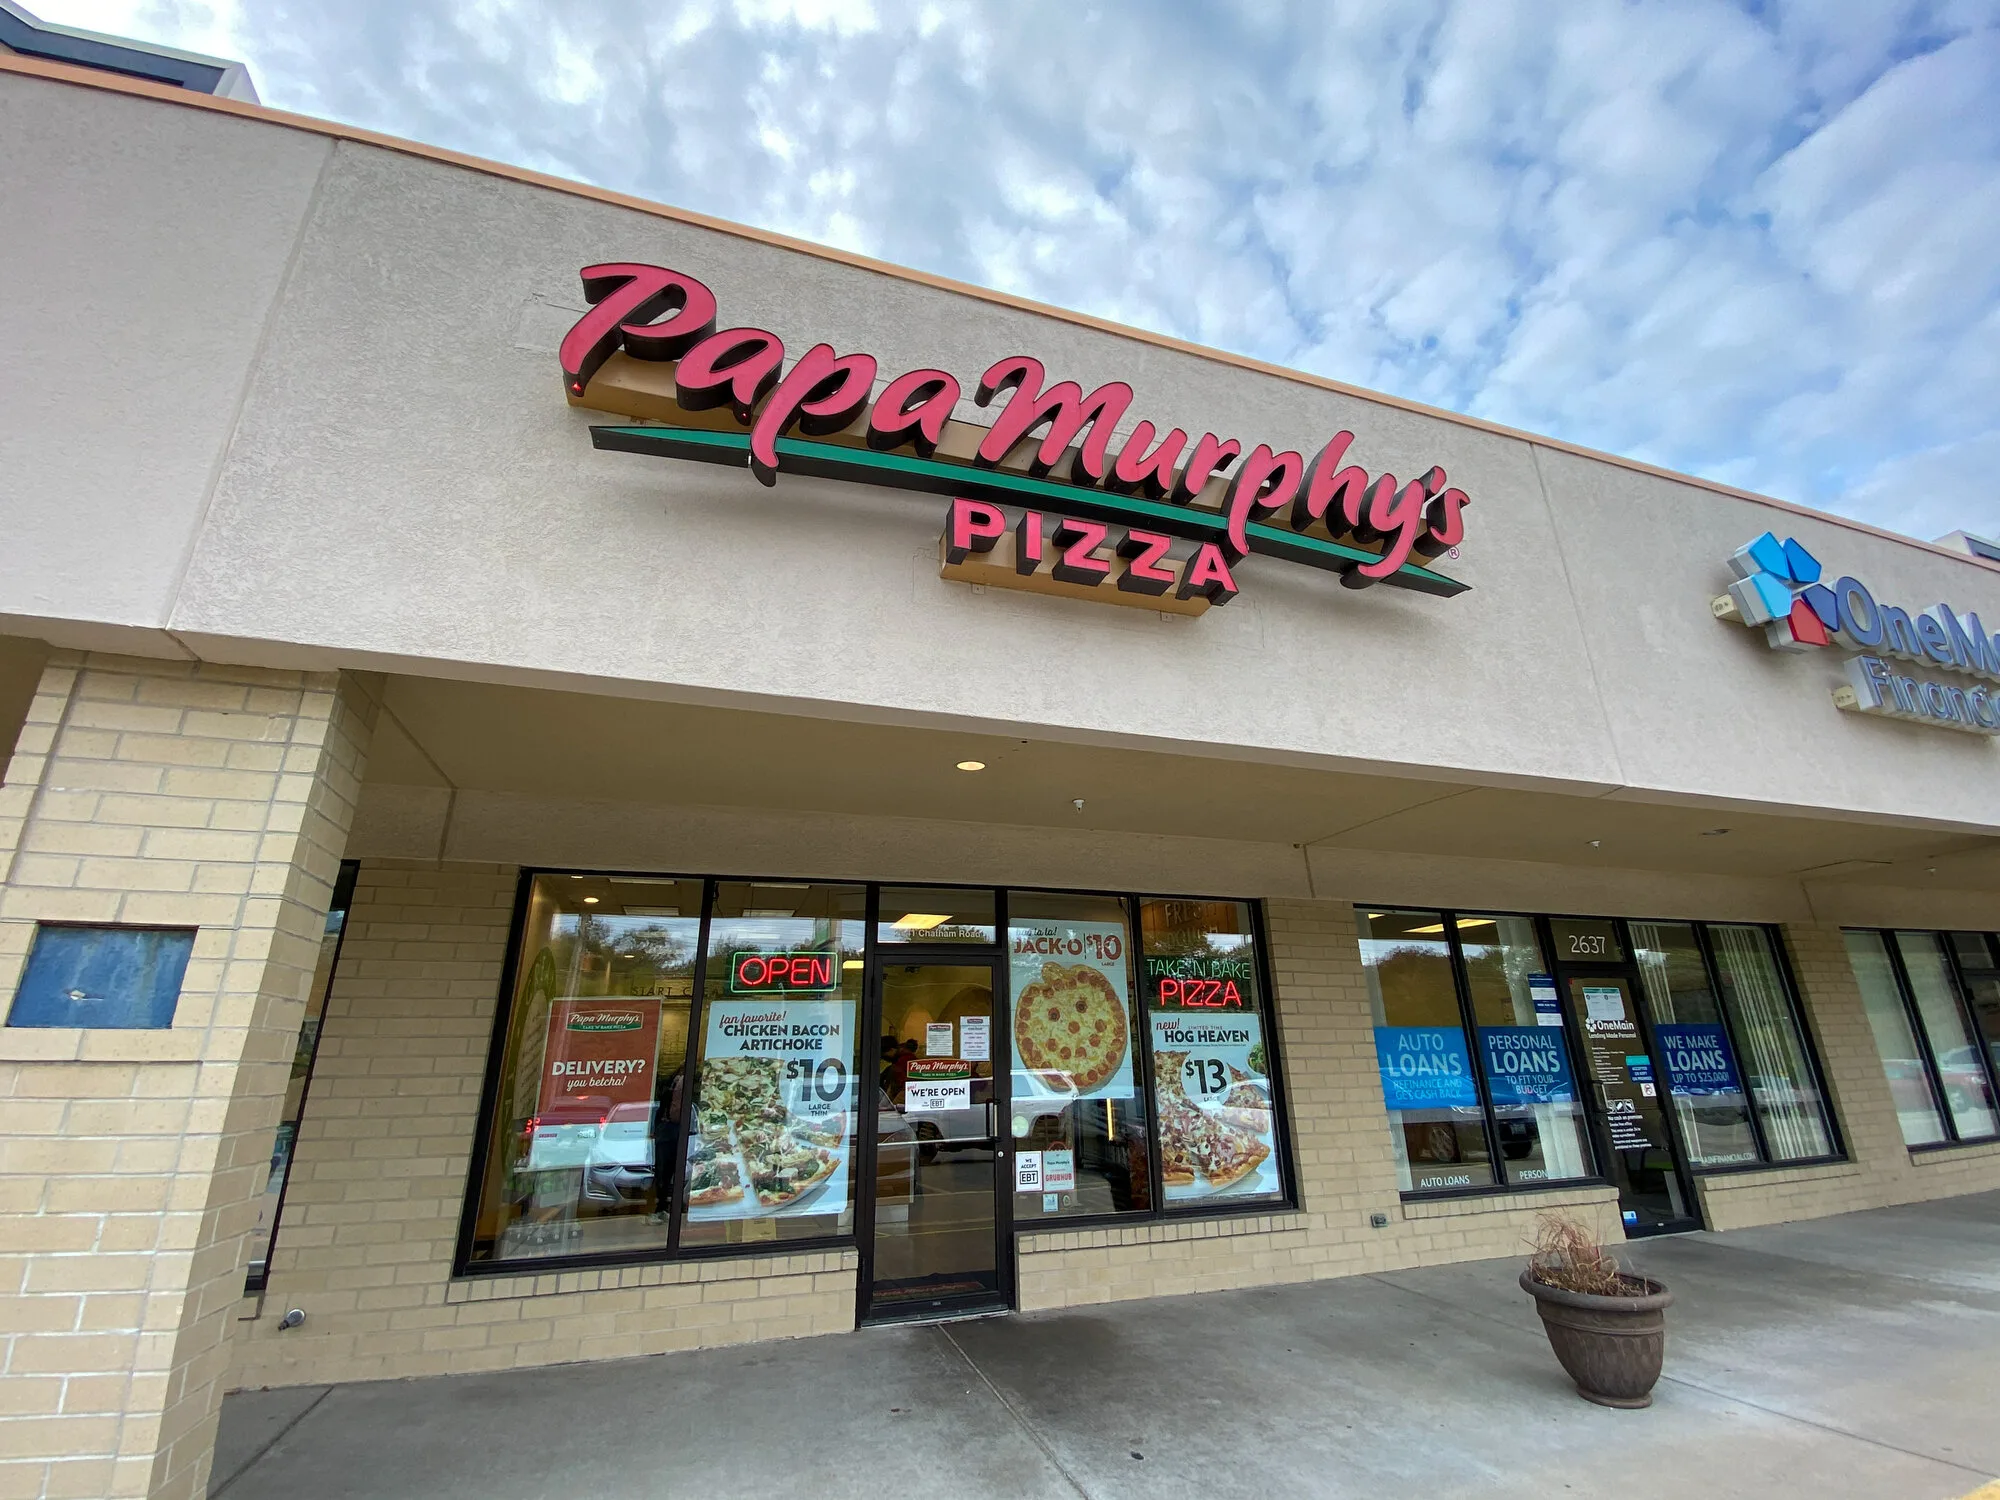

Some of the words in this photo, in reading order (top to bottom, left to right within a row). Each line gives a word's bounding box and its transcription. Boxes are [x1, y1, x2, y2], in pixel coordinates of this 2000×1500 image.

[559, 262, 961, 487] Papa
[975, 356, 1470, 588] Murphy's
[946, 498, 1238, 605] PIZZA
[960, 930, 981, 938] Road
[1014, 937, 1083, 956] JACK-O
[1086, 934, 1122, 960] $10
[1568, 935, 1606, 954] 2637
[739, 957, 830, 985] OPEN
[1147, 959, 1186, 976] TAKE
[1211, 960, 1251, 979] BAKE
[1160, 979, 1242, 1006] PIZZA
[570, 1013, 596, 1025] Papa
[597, 1013, 640, 1025] Murphy's
[719, 1014, 739, 1029] fan
[741, 1011, 787, 1026] favorite!
[1156, 1018, 1180, 1030] new!
[1597, 1020, 1634, 1030] OneMain
[724, 1025, 788, 1036] CHICKEN
[792, 1025, 840, 1036] BACON
[1164, 1030, 1194, 1043] HOG
[1197, 1030, 1249, 1042] HEAVEN
[739, 1039, 823, 1050] ARTICHOKE
[1398, 1033, 1444, 1051] AUTO
[1488, 1035, 1556, 1050] PERSONAL
[1664, 1035, 1685, 1049] WE
[1686, 1035, 1719, 1048] MAKE
[552, 1059, 646, 1076] DELIVERY?
[910, 1062, 931, 1073] Papa
[932, 1061, 968, 1073] Murphy's
[1386, 1053, 1462, 1077] LOANS
[1491, 1050, 1560, 1074] LOANS
[1666, 1050, 1726, 1071] LOANS
[567, 1078, 588, 1091] you
[589, 1076, 627, 1087] betcha!
[786, 1057, 846, 1102] $10
[1185, 1059, 1227, 1094] $13
[1444, 1079, 1463, 1088] AND
[1505, 1075, 1516, 1084] TO
[1518, 1075, 1530, 1084] FIT
[1532, 1075, 1553, 1084] YOUR
[1672, 1073, 1684, 1083] UP
[1684, 1073, 1697, 1082] TO
[911, 1088, 938, 1097] WE'RE
[941, 1088, 965, 1096] OPEN
[1415, 1089, 1438, 1099] CASH
[1439, 1088, 1462, 1099] BACK
[1515, 1084, 1548, 1095] BUDGET
[1021, 1173, 1036, 1182] EBT
[1046, 1173, 1072, 1181] GRUBHUB
[1420, 1177, 1443, 1188] AUTO
[1444, 1175, 1470, 1186] LOANS
